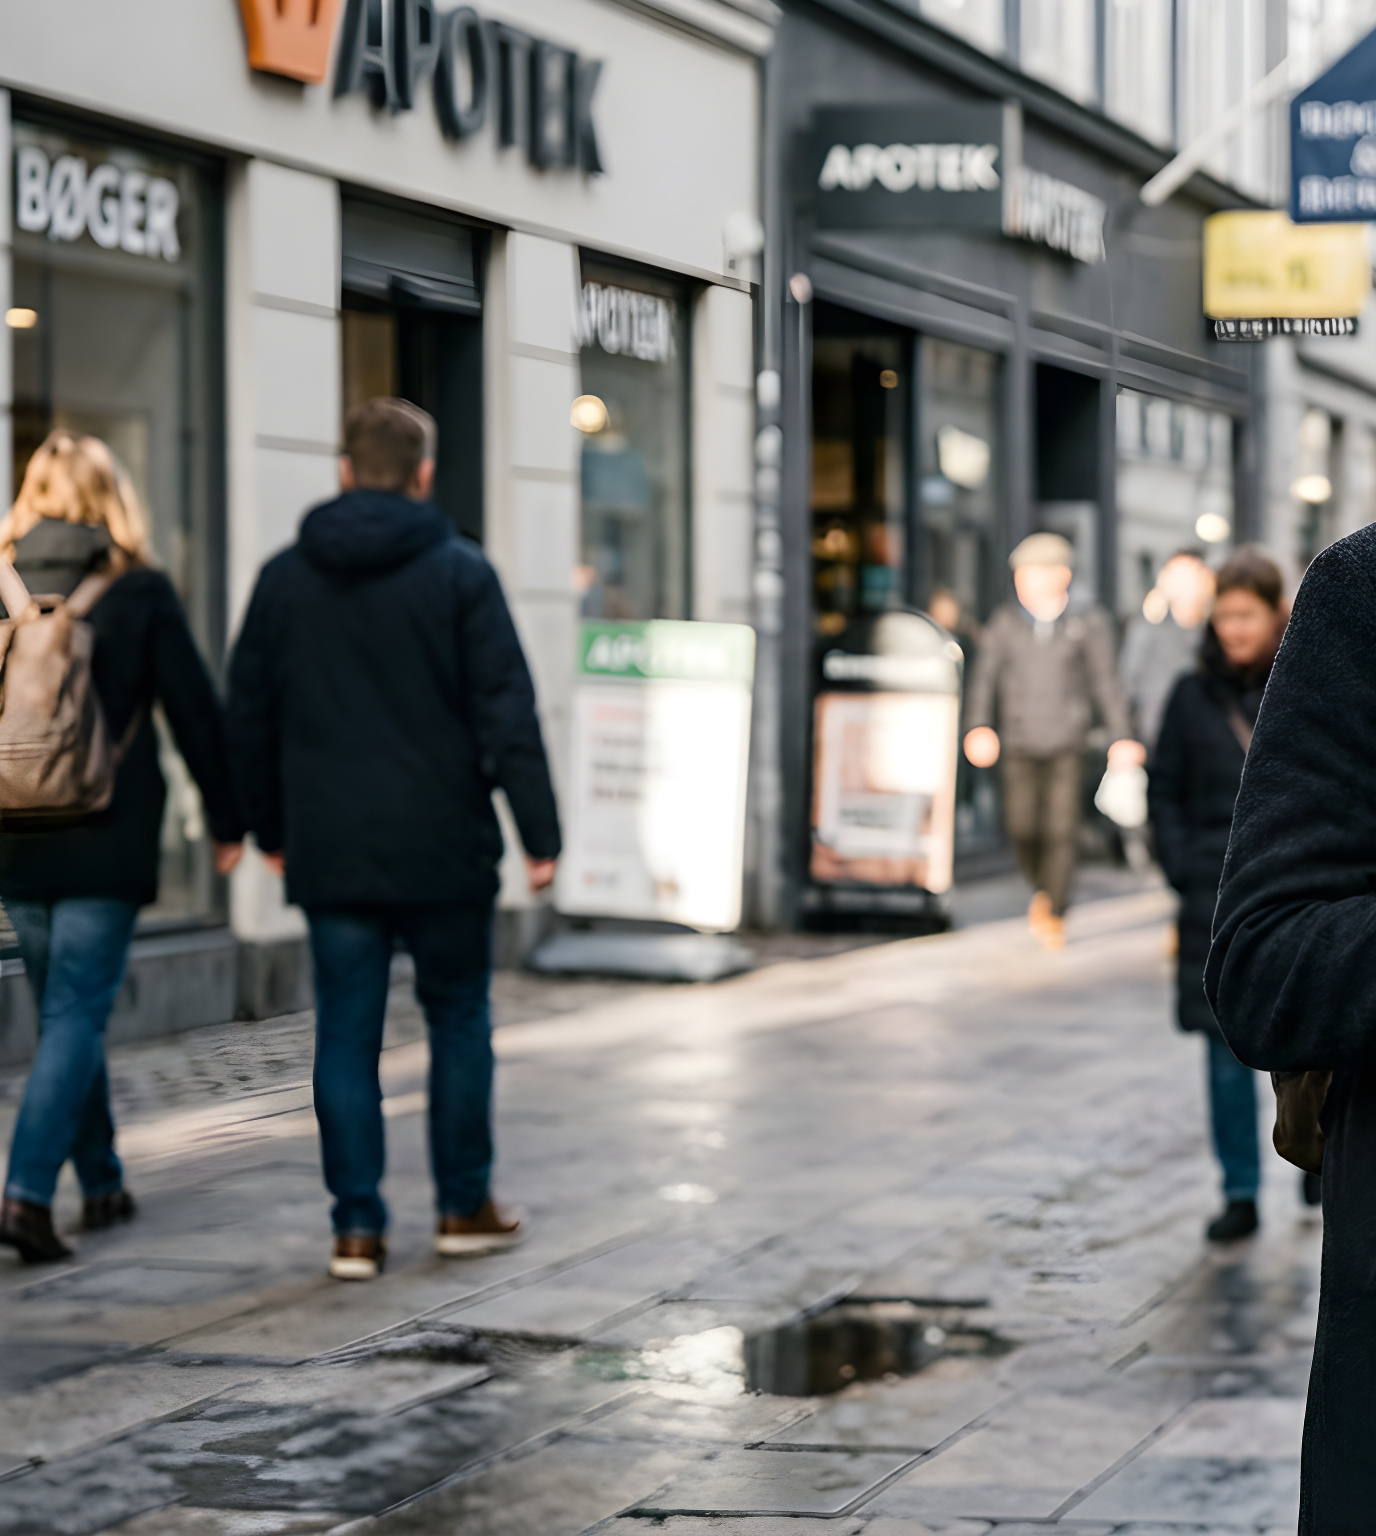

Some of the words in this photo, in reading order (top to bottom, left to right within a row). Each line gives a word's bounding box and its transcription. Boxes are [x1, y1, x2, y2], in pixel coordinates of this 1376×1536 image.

[332, 0, 605, 174] APOTEK
[17, 146, 181, 263] BØGER
[818, 142, 1001, 193] APOTEK
